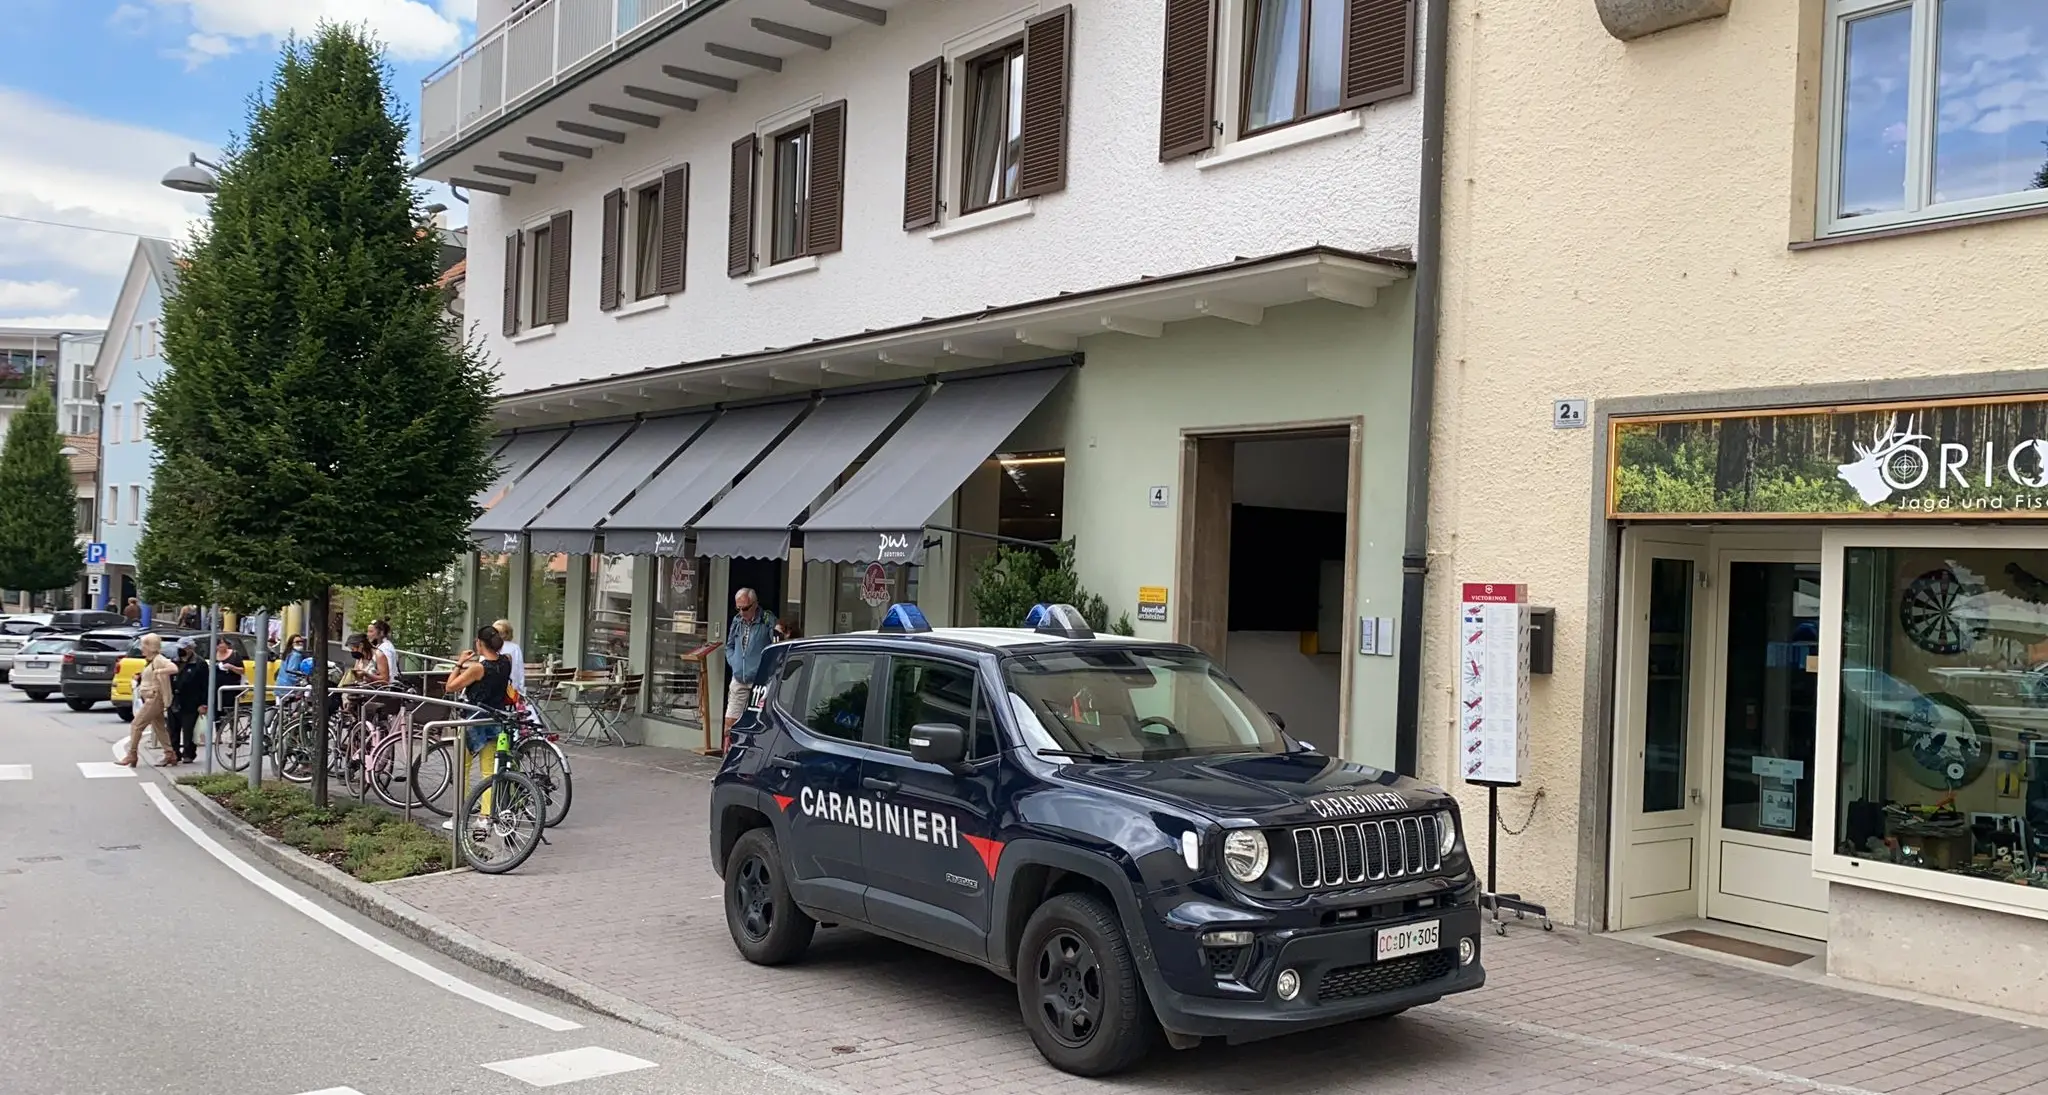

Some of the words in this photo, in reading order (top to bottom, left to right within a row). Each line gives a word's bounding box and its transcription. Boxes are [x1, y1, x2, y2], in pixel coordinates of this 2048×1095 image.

[1155, 489, 1162, 501] 4
[1898, 496, 1950, 513] Jagd
[1962, 495, 2001, 509] und
[2015, 494, 2048, 509] Fis
[91, 545, 103, 562] P
[655, 532, 676, 554] pur
[878, 533, 909, 561] pur
[750, 685, 768, 708] 112
[1310, 792, 1409, 818] CARABINIERI
[800, 786, 959, 849] CARABINIERI
